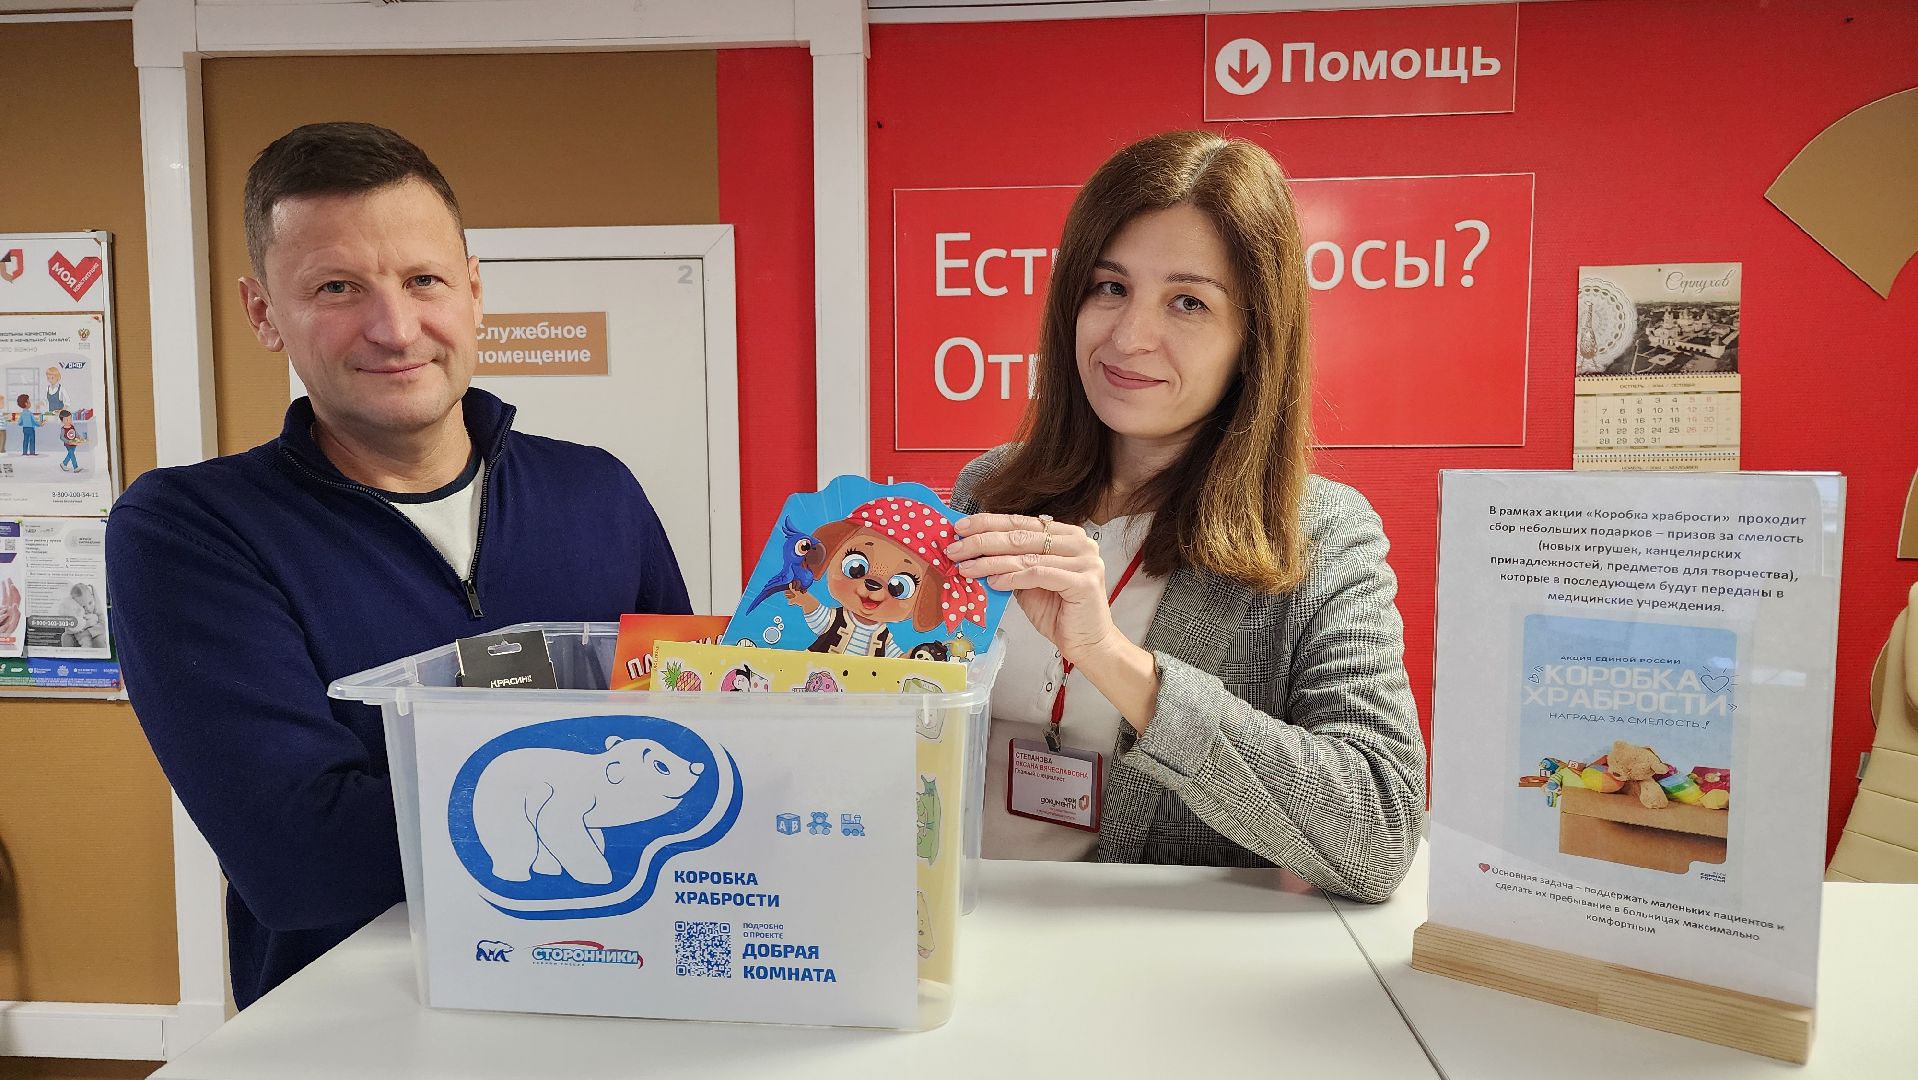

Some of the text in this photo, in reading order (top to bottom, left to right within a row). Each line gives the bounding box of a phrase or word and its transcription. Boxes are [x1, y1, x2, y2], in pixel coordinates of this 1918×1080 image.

[1281, 42, 1501, 84] Помощь
[936, 219, 1491, 297] Ест осы?
[51, 261, 77, 288] МОЯ
[677, 264, 694, 285] 2
[1665, 269, 1736, 293] Серпухов
[1489, 505, 1807, 526] В рамках акции «Коробка храбрости» проходит
[1489, 522, 1516, 533] сбор
[1519, 523, 1588, 535] небольших
[1590, 528, 1653, 539] подарков
[1667, 530, 1716, 541] призов
[1719, 533, 1734, 541] за
[1738, 533, 1804, 543] смелость
[1538, 540, 1742, 560] (новых игрушек, канцелярских
[1490, 556, 1799, 582] принадлежностей, предметов для творчества),
[1500, 573, 1784, 598] которые в последующем будут переданы в
[1547, 593, 1725, 612] медицинские учреждения.
[1549, 712, 1605, 722] НАГРАДА
[1608, 715, 1625, 723] ЗА
[1015, 752, 1053, 764] СТЕПАНОВА
[1015, 761, 1039, 770] ОКСАНА
[674, 870, 758, 886] КОРОБКА
[674, 891, 780, 907] ХРАБРОСТИ
[1492, 866, 1538, 882] Основная
[1540, 877, 1574, 890] задача
[1584, 886, 1649, 905] поддержать
[1650, 899, 1711, 917] маленьких
[1714, 911, 1774, 930] пациентов
[1495, 881, 1760, 941] сделать их пребывание в больницах максимально
[743, 922, 784, 930] ПОДРОБНО
[1586, 913, 1656, 934] комфортным
[750, 931, 784, 939] ПРОЕКТЕ
[532, 947, 639, 964] СТОРОННИКИ
[742, 943, 820, 960] ДОБРАЯ
[743, 965, 837, 983] КОМНАТА
